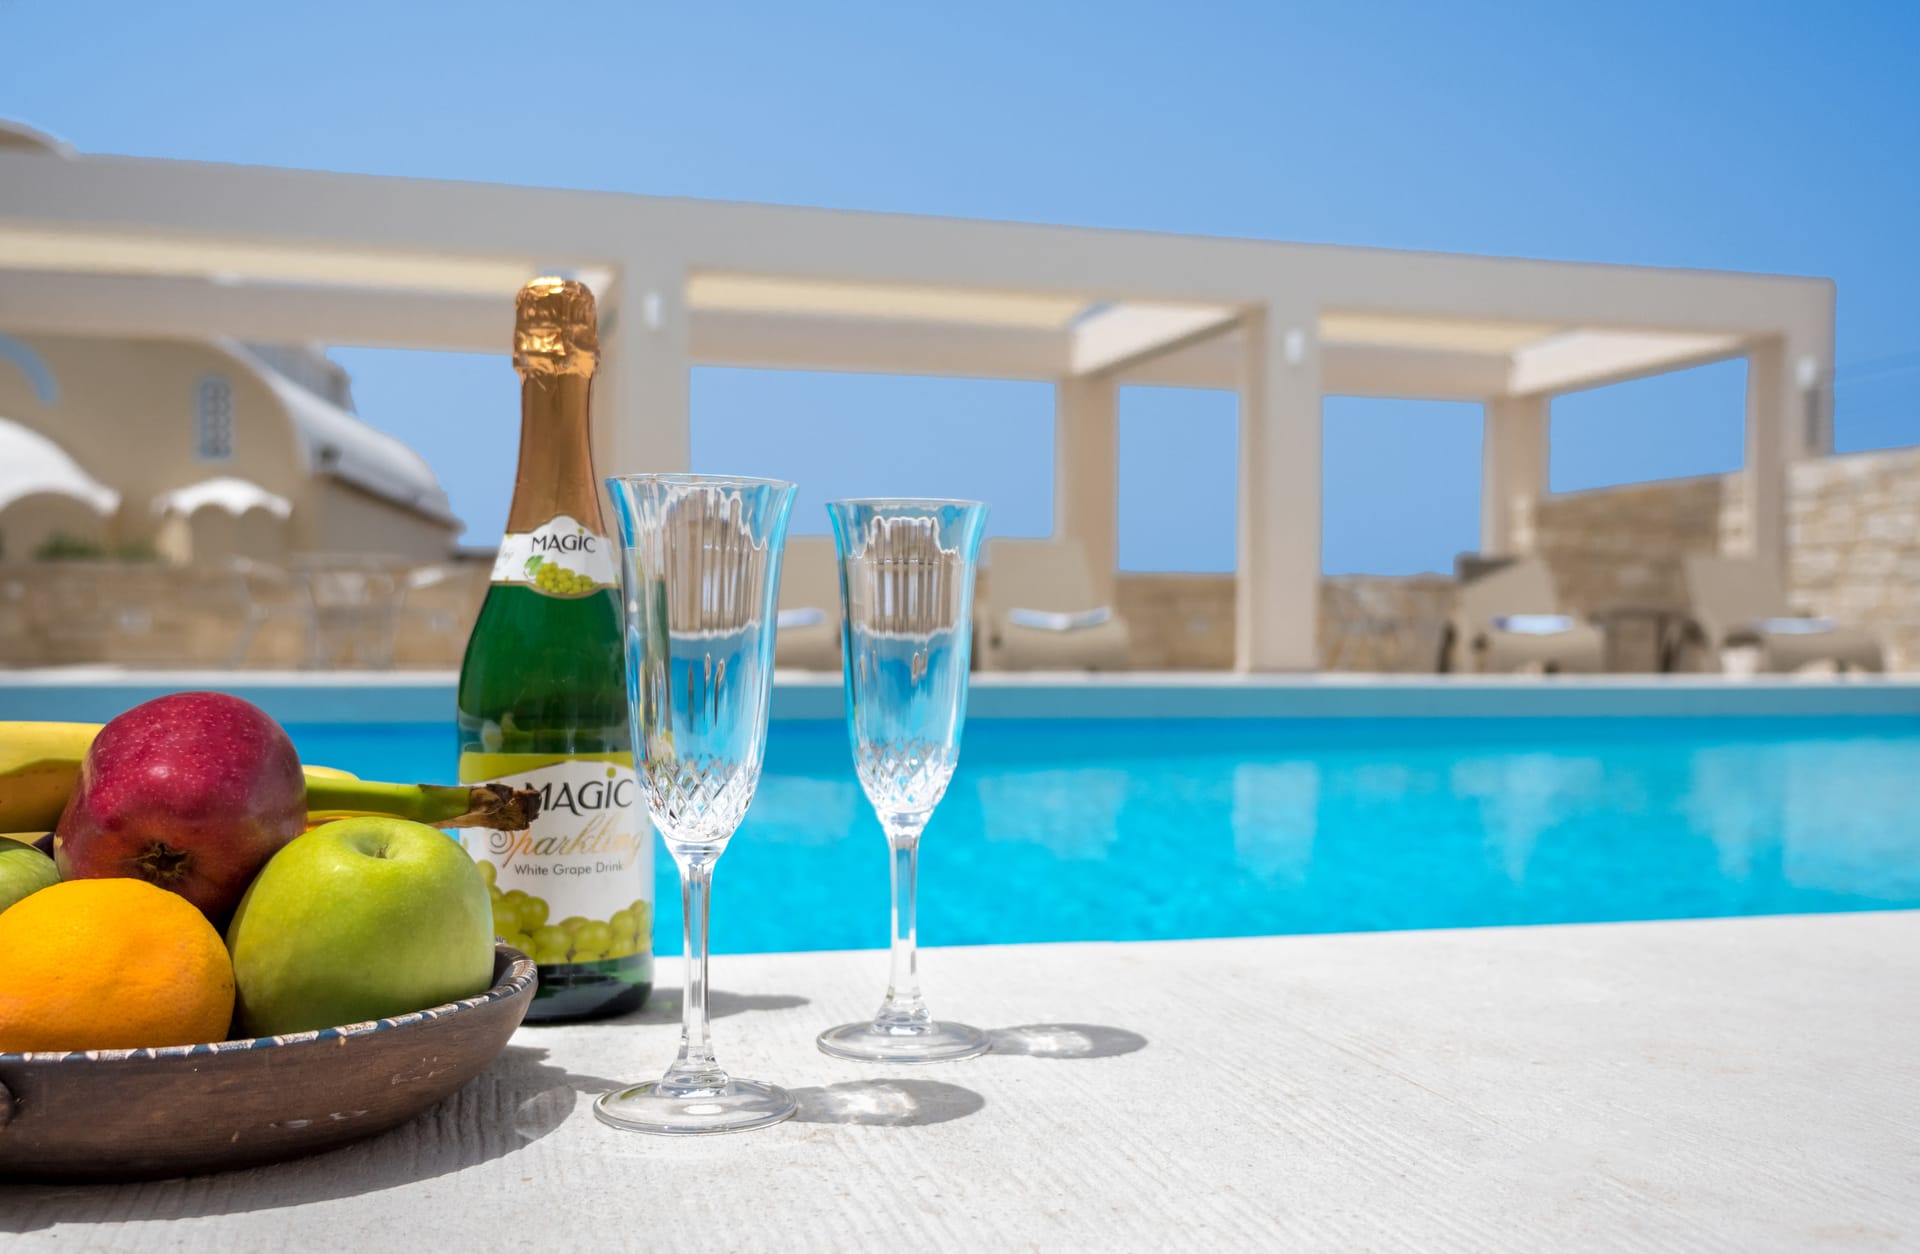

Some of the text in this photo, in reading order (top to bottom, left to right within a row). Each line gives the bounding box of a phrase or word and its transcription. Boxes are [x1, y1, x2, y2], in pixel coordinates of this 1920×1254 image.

[489, 813, 644, 870] Sparkling
[515, 860, 624, 876] White Grape Drink
